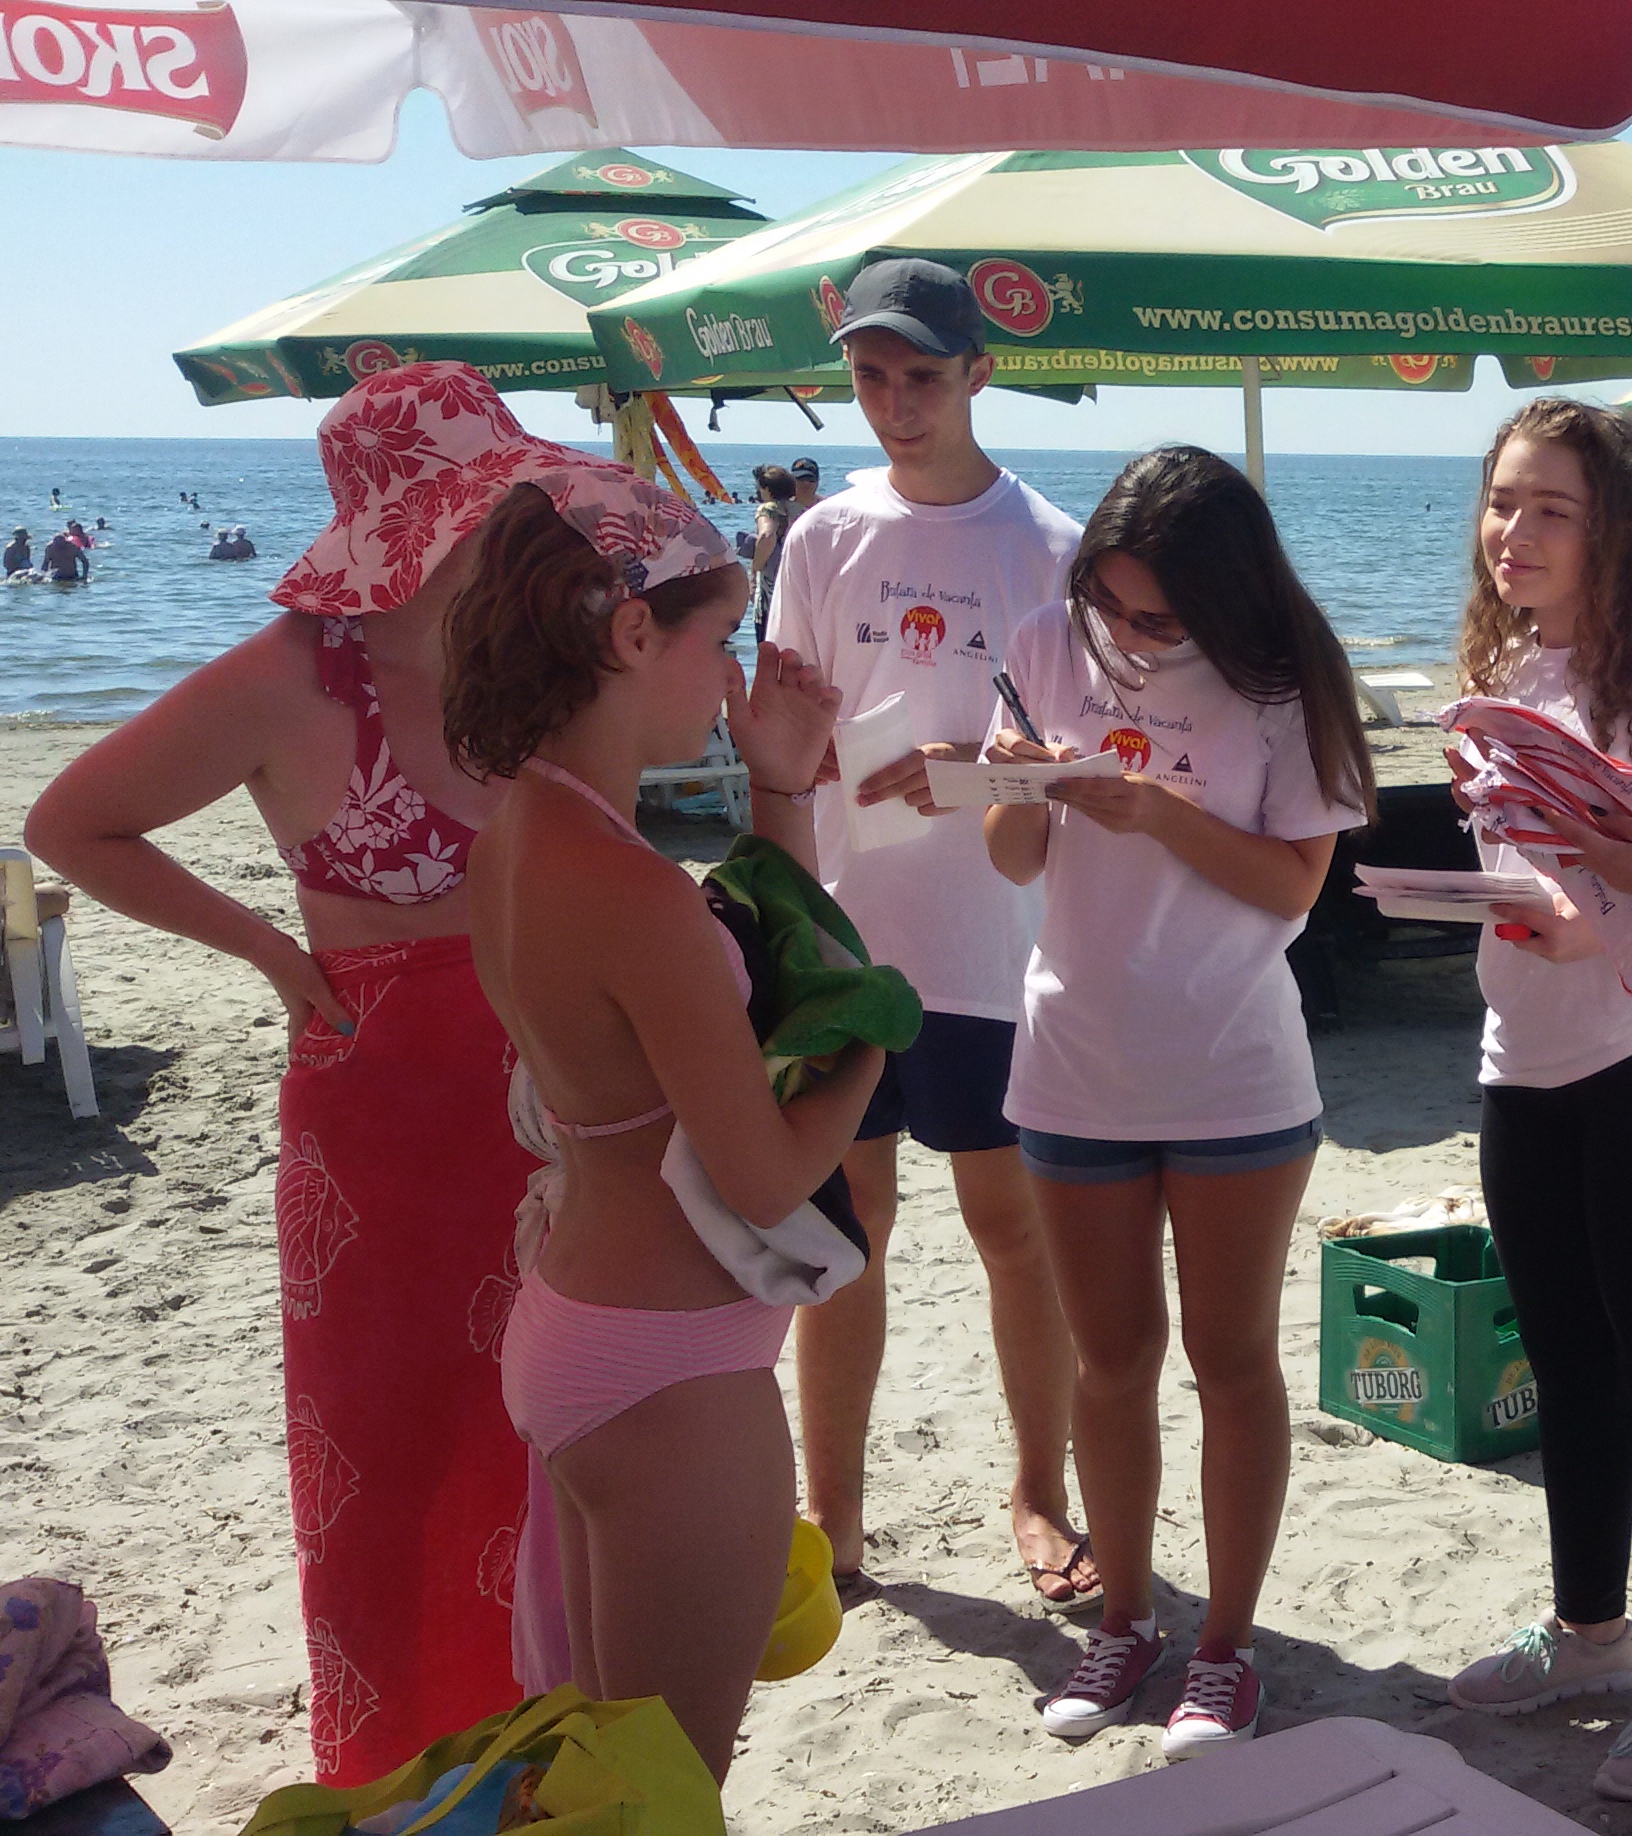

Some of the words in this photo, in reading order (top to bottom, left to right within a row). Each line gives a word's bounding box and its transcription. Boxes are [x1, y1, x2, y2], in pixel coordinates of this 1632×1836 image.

[1404, 178, 1501, 201] Brau
[684, 306, 741, 368] Golden
[729, 312, 775, 351] Brau
[953, 649, 999, 664] ANGELINI
[1155, 773, 1208, 788] ANGELINI
[1351, 1368, 1424, 1401] TUBORG
[1486, 1387, 1536, 1429] TUB
